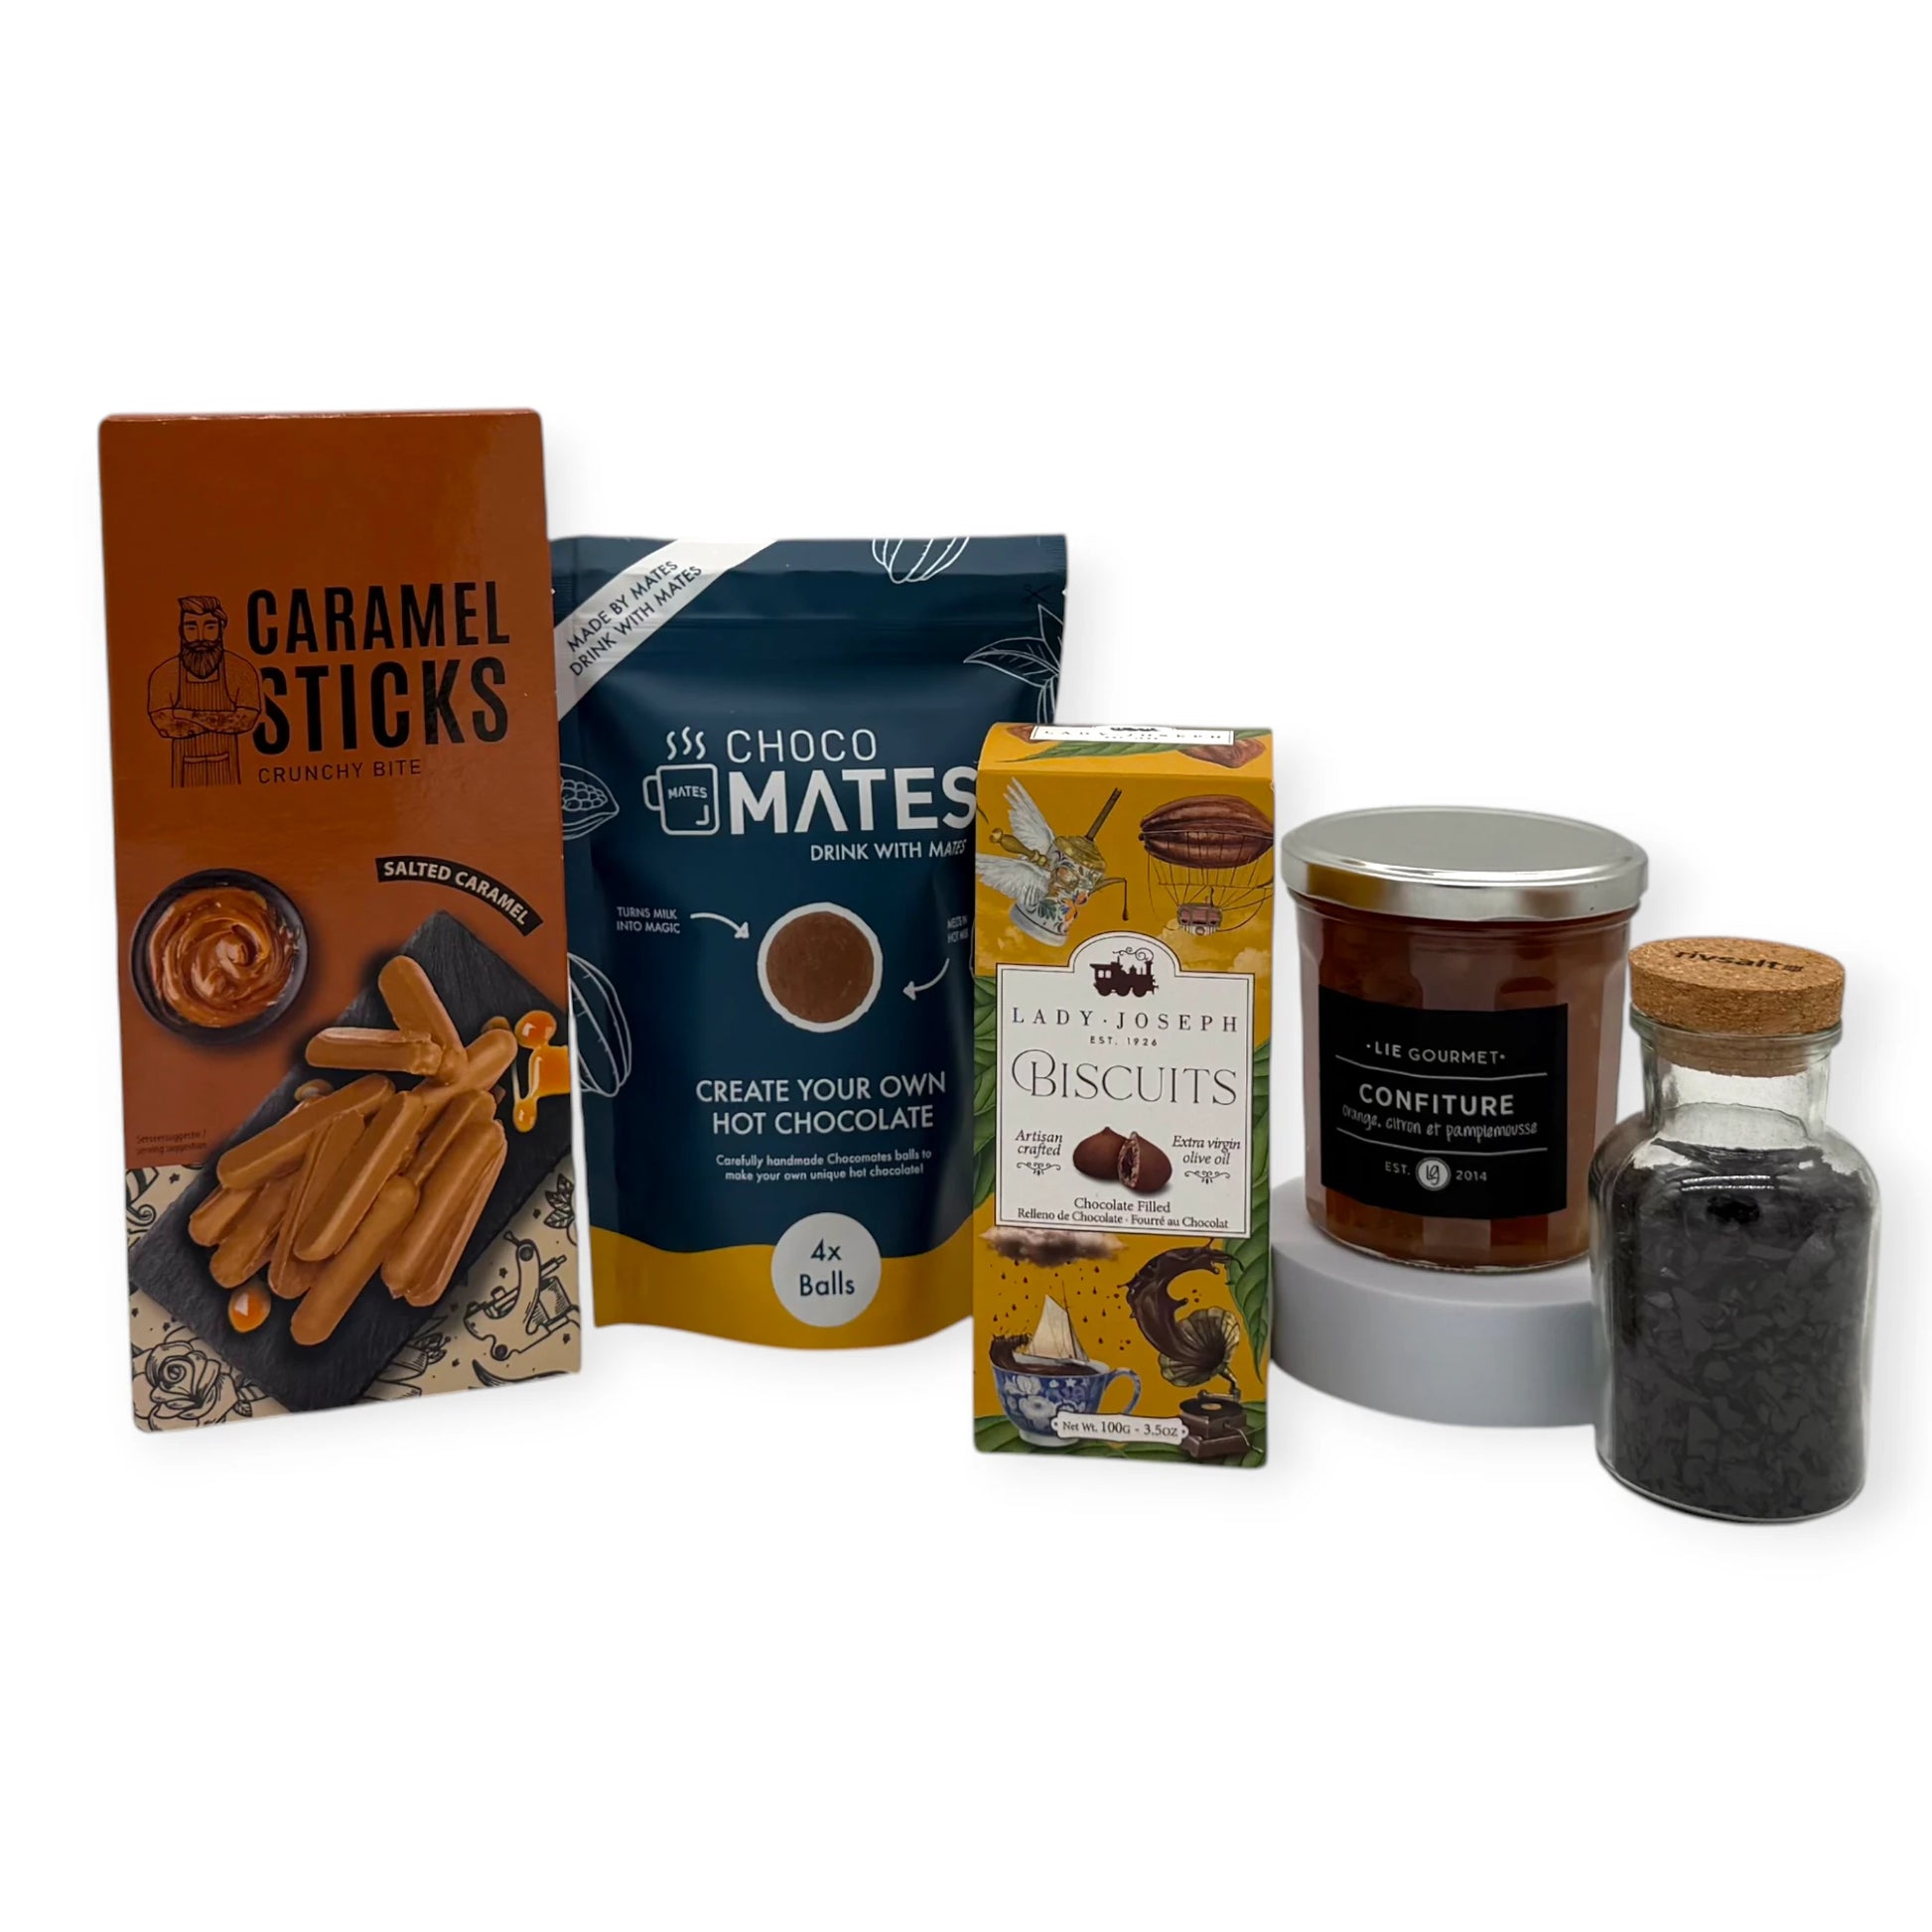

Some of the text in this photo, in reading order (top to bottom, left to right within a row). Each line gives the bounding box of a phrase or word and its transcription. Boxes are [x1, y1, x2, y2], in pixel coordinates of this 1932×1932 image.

[567, 561, 678, 652] MADE BY MATES
[246, 581, 510, 655] CARAMEL
[569, 566, 702, 676] DRINK WITH MATES
[251, 656, 508, 755] STICKS
[726, 729, 877, 763] CHOCO
[258, 759, 422, 783] CRUNCHY BITE
[667, 784, 708, 800] MATES
[728, 765, 978, 836] MATES
[810, 839, 967, 861] DRINK WITH MATES
[383, 861, 529, 925] SALTED CARAMEL
[617, 905, 678, 919] TURNS MILK
[617, 920, 681, 934] INTO MAGIC
[1012, 1007, 1238, 1033] LADY JOSEPH
[1089, 1035, 1158, 1046] EST. 1926
[1408, 1047, 1499, 1064] GOURMET
[696, 1071, 946, 1103] CREATE YOUR OWN
[1358, 1083, 1515, 1117] CONFITURE
[712, 1105, 934, 1136] HOT CHOCOLATE
[1385, 1117, 1421, 1135] citron
[1426, 1123, 1442, 1136] et
[1446, 1122, 1538, 1144] pamplemousse
[1015, 1129, 1063, 1144] Artisan
[1172, 1135, 1241, 1154] Extra virgin
[716, 1148, 932, 1169] Carefully handmade Chocomates balls to
[1017, 1142, 1061, 1159] crafted
[1182, 1152, 1230, 1166] olive oil
[725, 1163, 924, 1183] make your own unique hot chocolate!
[1384, 1161, 1411, 1176] EST.
[1455, 1170, 1487, 1181] 2014
[1073, 1196, 1171, 1213] Chocolate Filled
[1017, 1207, 1229, 1229] Relleno de Chocolate Fourré au Chocolat
[810, 1238, 843, 1261] 4x
[799, 1270, 856, 1297] Balls
